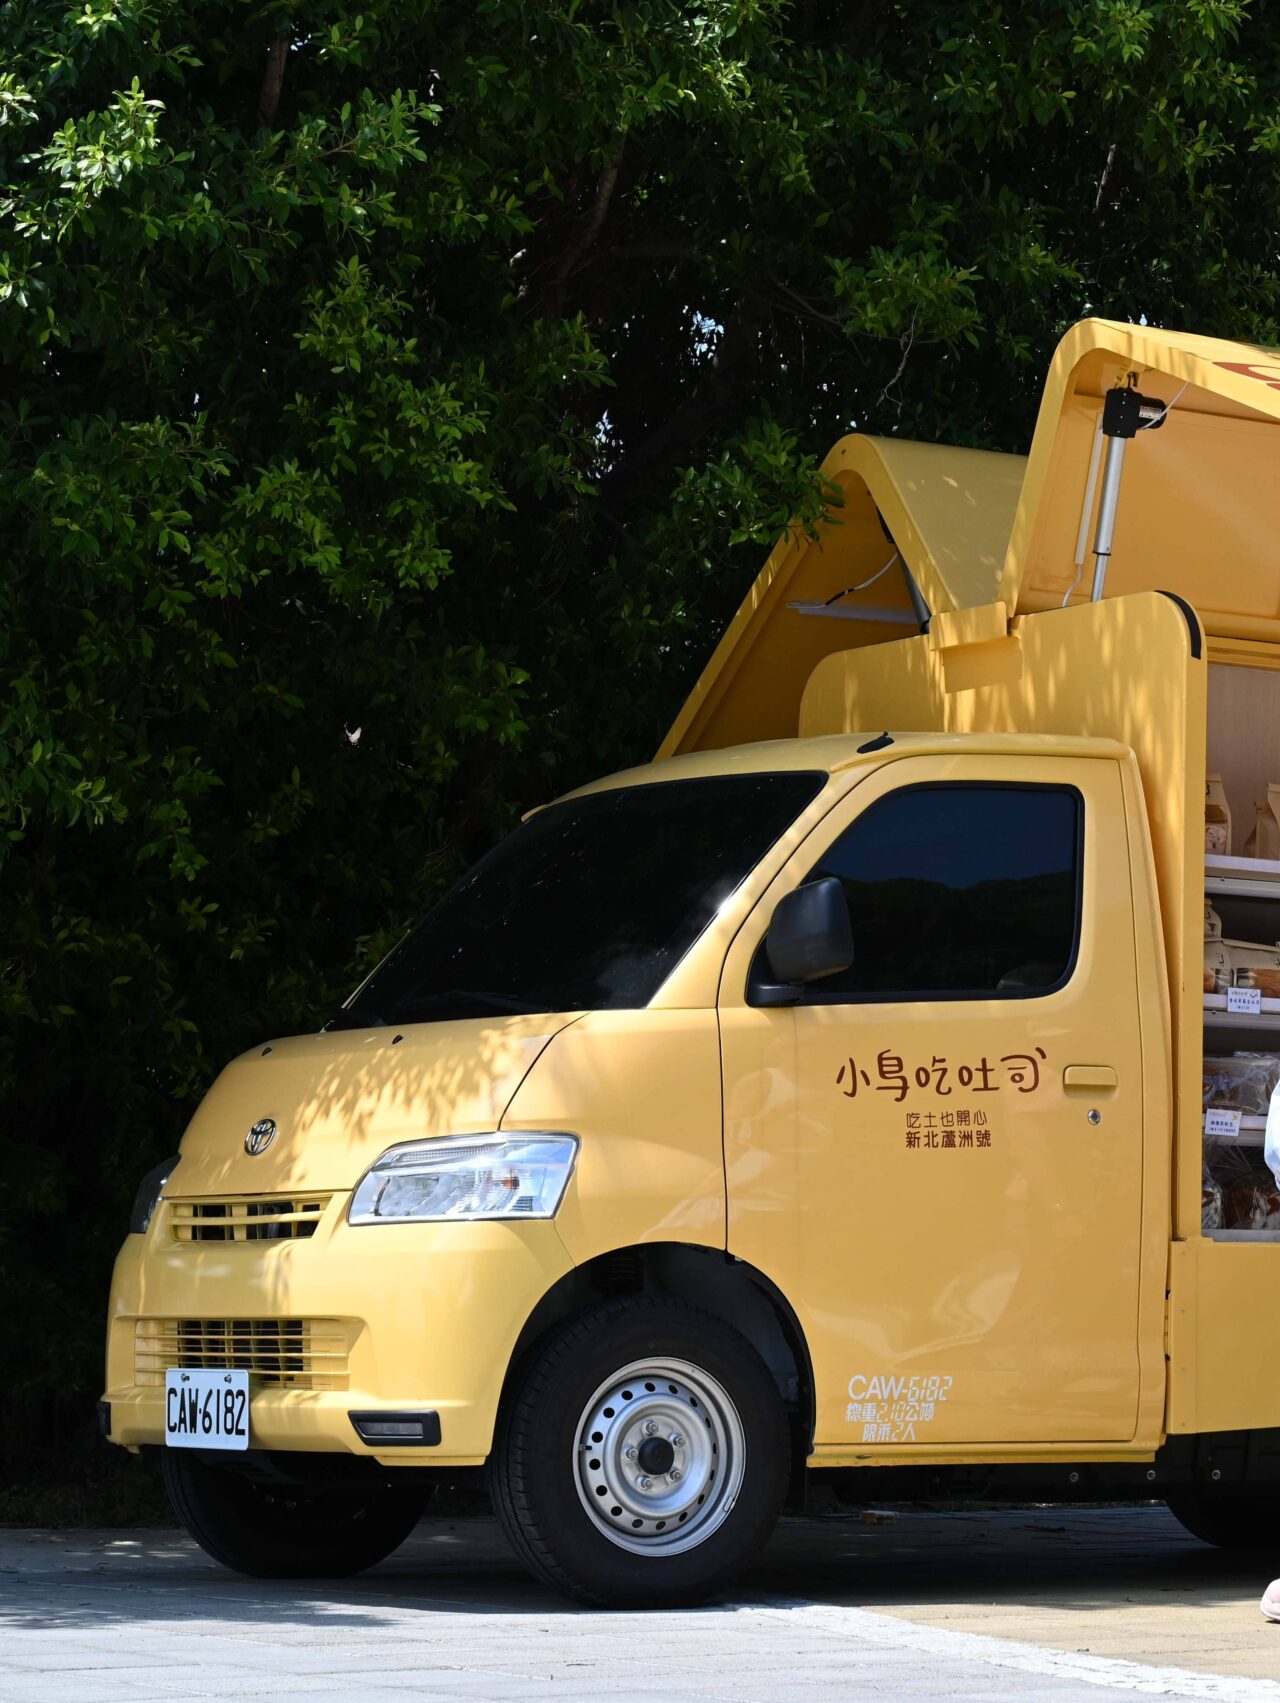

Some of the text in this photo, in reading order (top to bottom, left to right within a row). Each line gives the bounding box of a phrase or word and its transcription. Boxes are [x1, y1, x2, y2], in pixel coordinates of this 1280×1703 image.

[905, 1109, 988, 1129] 吃土也開心
[905, 1129, 992, 1149] 新北蘆洲號
[847, 1373, 953, 1402] CAW-6182
